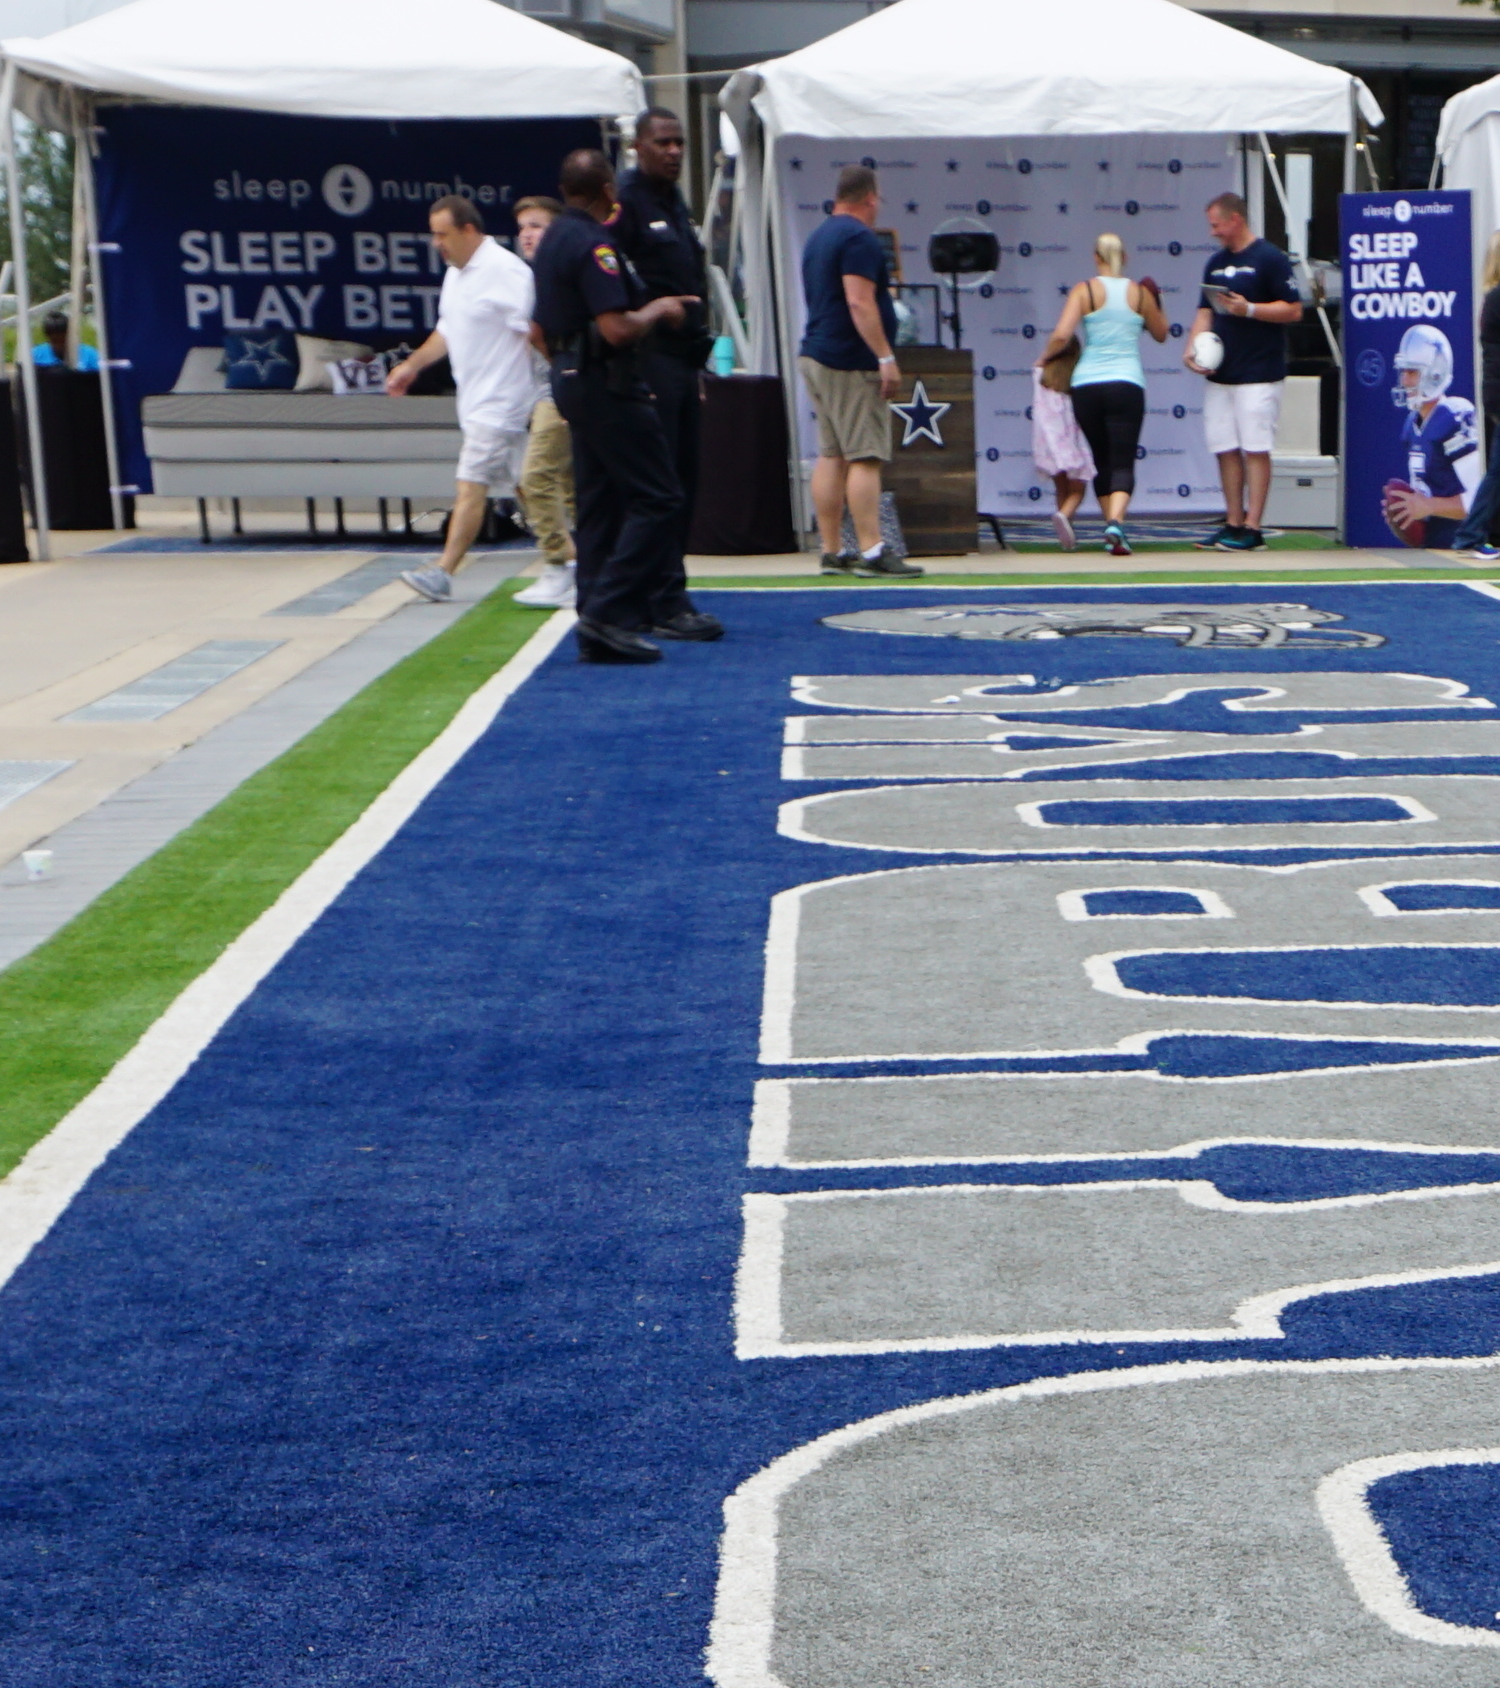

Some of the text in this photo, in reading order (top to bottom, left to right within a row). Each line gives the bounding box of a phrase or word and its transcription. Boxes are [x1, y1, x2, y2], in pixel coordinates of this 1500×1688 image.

[214, 171, 512, 208] sleep number
[179, 230, 336, 274] SLEEP
[1349, 231, 1418, 260] SLEEP
[1350, 261, 1426, 290] LIKE A
[184, 284, 442, 330] PLAY BET
[1350, 290, 1457, 320] COWBOY
